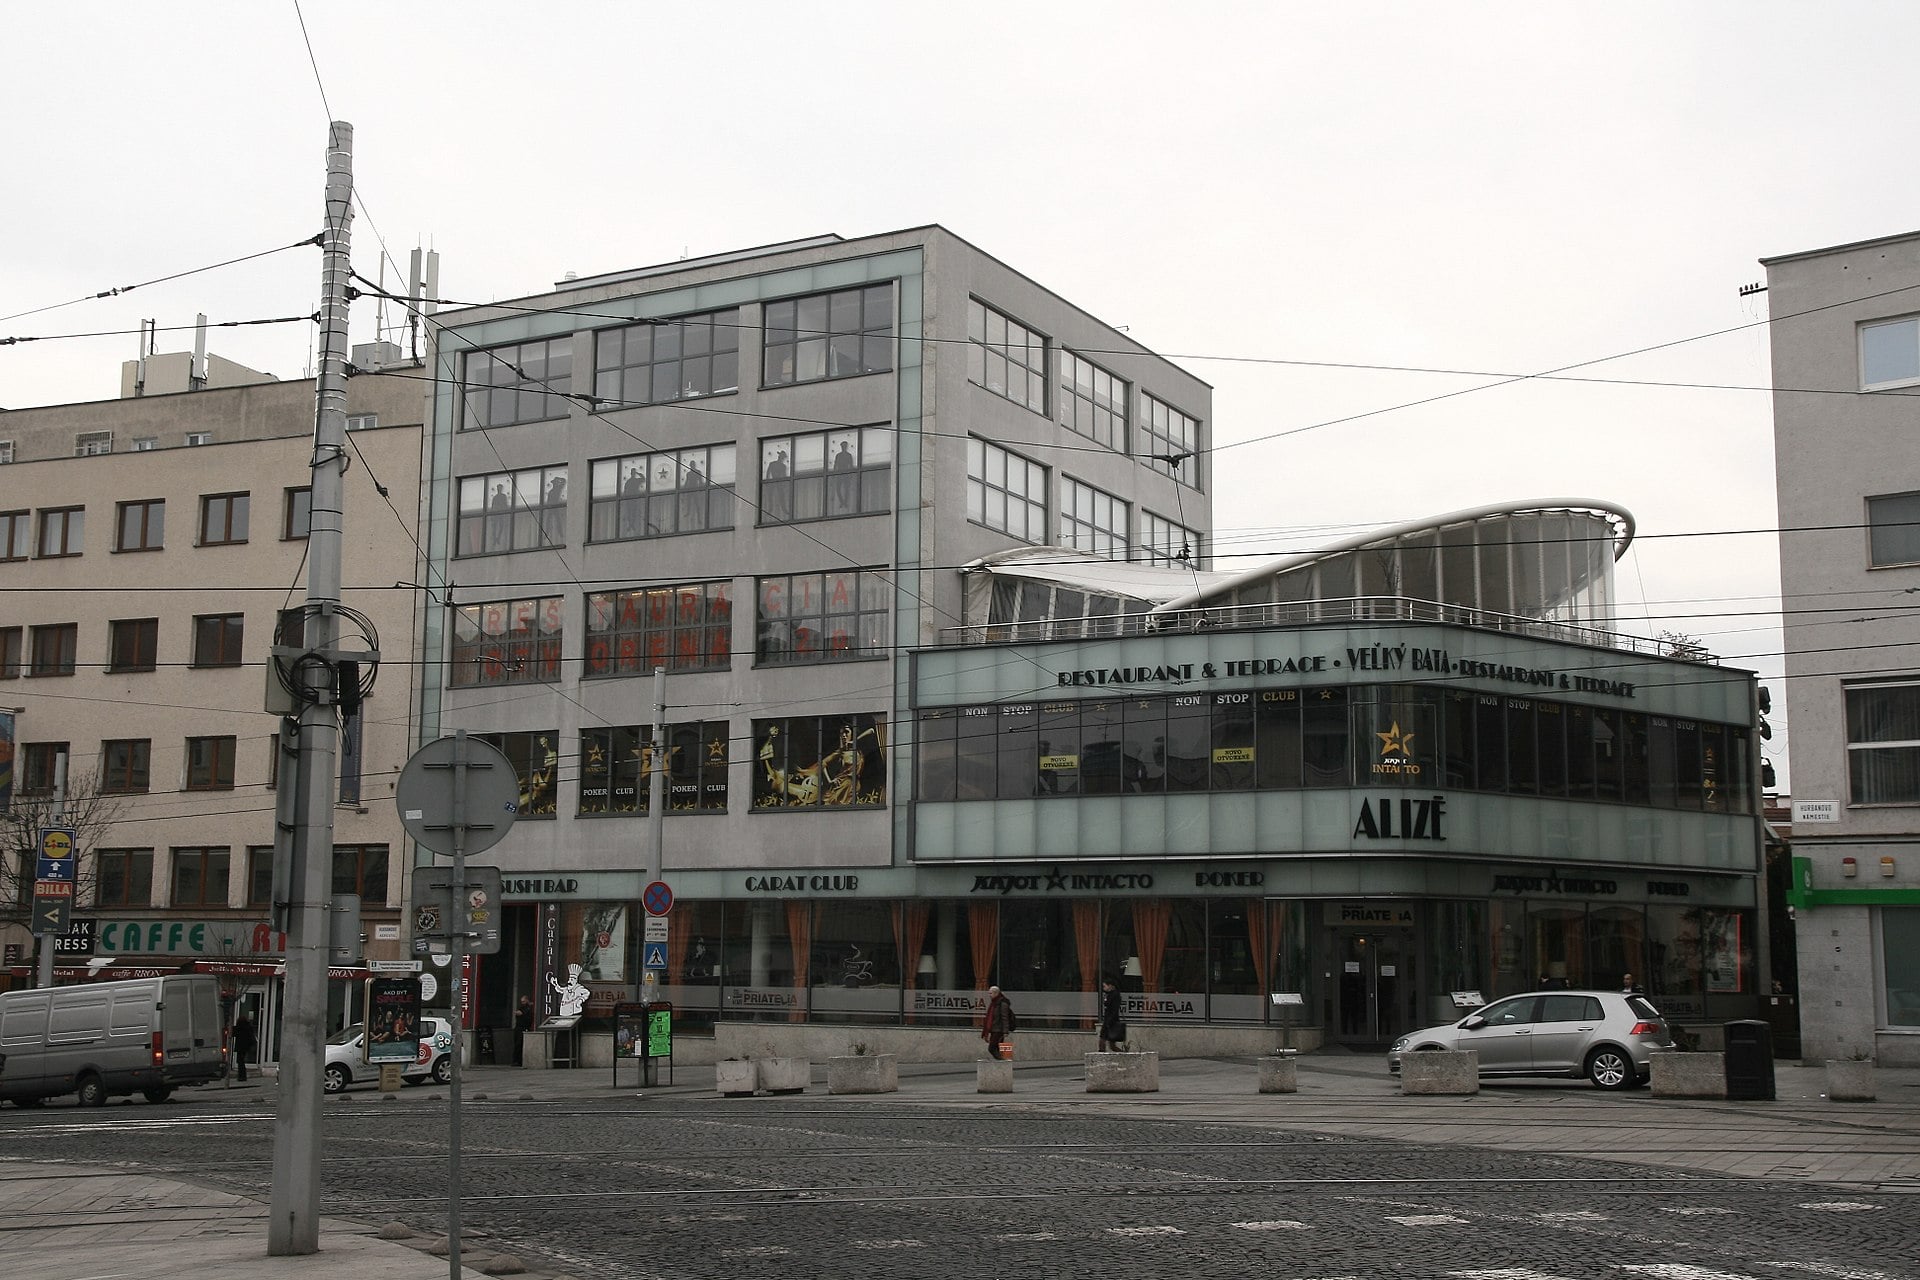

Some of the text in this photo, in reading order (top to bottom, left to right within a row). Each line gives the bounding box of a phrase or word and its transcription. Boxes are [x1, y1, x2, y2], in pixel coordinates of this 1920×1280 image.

[1058, 664, 1194, 687] RESTAURANT
[1202, 662, 1217, 678] &
[1224, 656, 1326, 677] TERRACE
[1175, 691, 1296, 706] NON STOP CLUB
[1480, 695, 1560, 714] NON STOP CLUB
[965, 702, 1075, 717] NON STOP CLUB
[1676, 719, 1696, 731] STOP
[583, 788, 608, 797] POKER
[615, 787, 634, 796] CLUB
[672, 785, 697, 794] POKER
[706, 784, 726, 792] CLUB
[44, 840, 70, 849] LIDL
[543, 878, 579, 893] BAR
[745, 875, 859, 892] CARAT CLUB
[1071, 874, 1154, 890] INTACTO
[1195, 871, 1265, 888] POKER
[36, 883, 71, 895] BILLA
[102, 923, 205, 951] CAFFE
[547, 918, 556, 966] Carat
